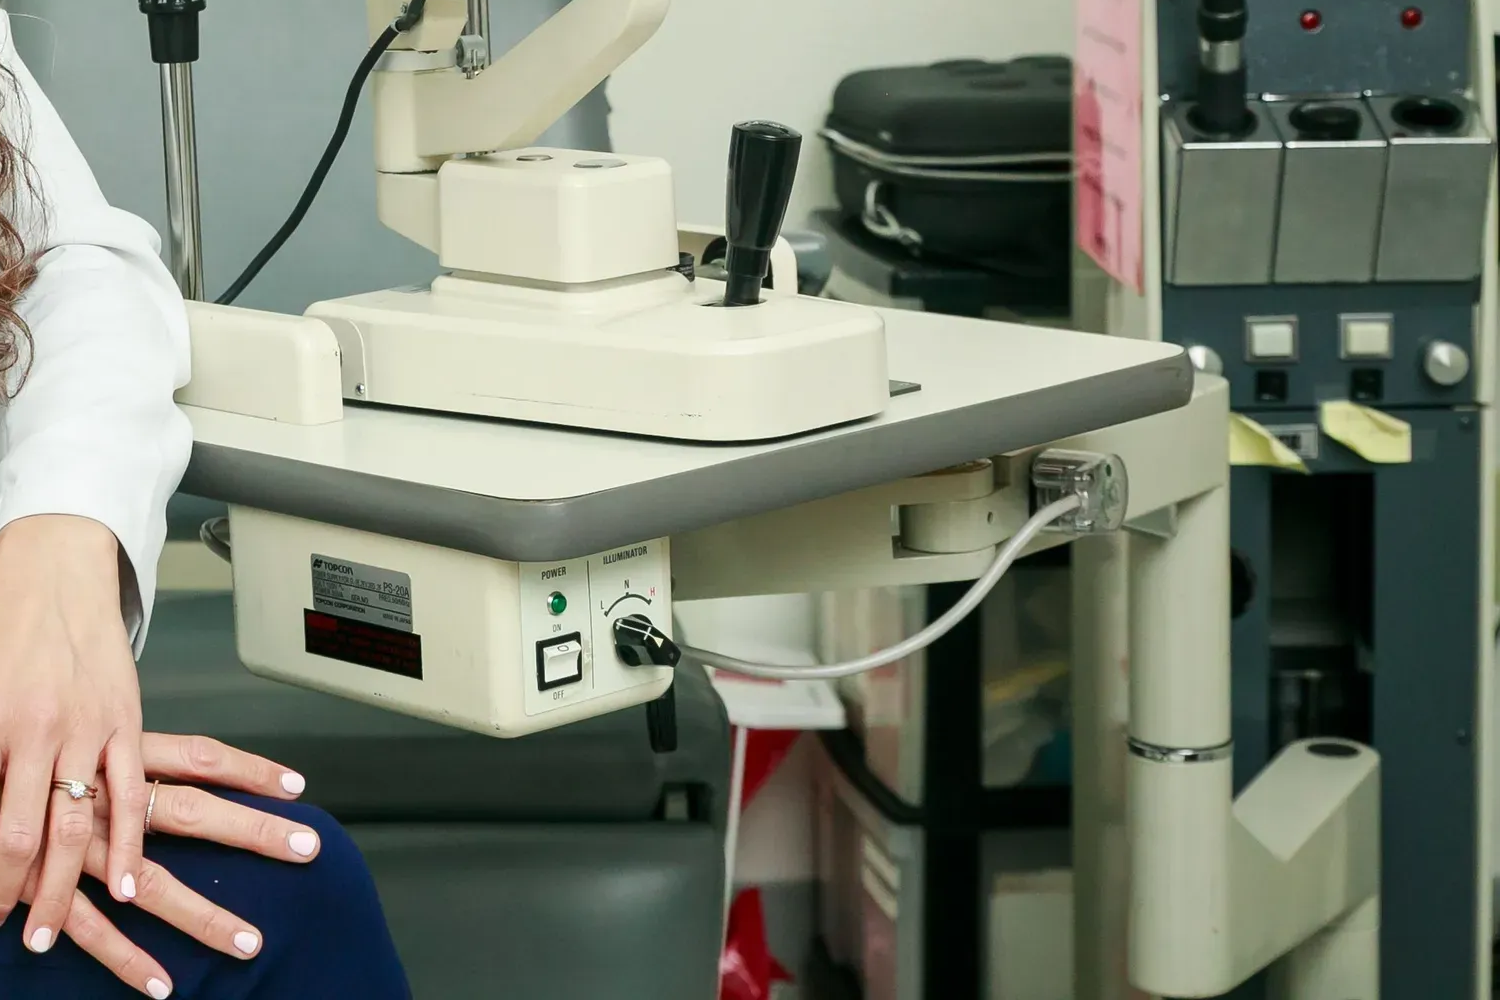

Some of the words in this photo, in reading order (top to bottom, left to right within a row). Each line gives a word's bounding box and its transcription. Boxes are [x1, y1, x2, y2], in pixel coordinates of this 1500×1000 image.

[603, 546, 648, 565] ILLUMINATOR
[323, 561, 354, 576] TOPCON
[541, 566, 567, 581] POWER
[382, 581, 410, 598] PS-20A
[623, 579, 630, 590] N
[650, 586, 656, 597] H
[552, 623, 562, 633] ON
[552, 690, 565, 701] OFF
